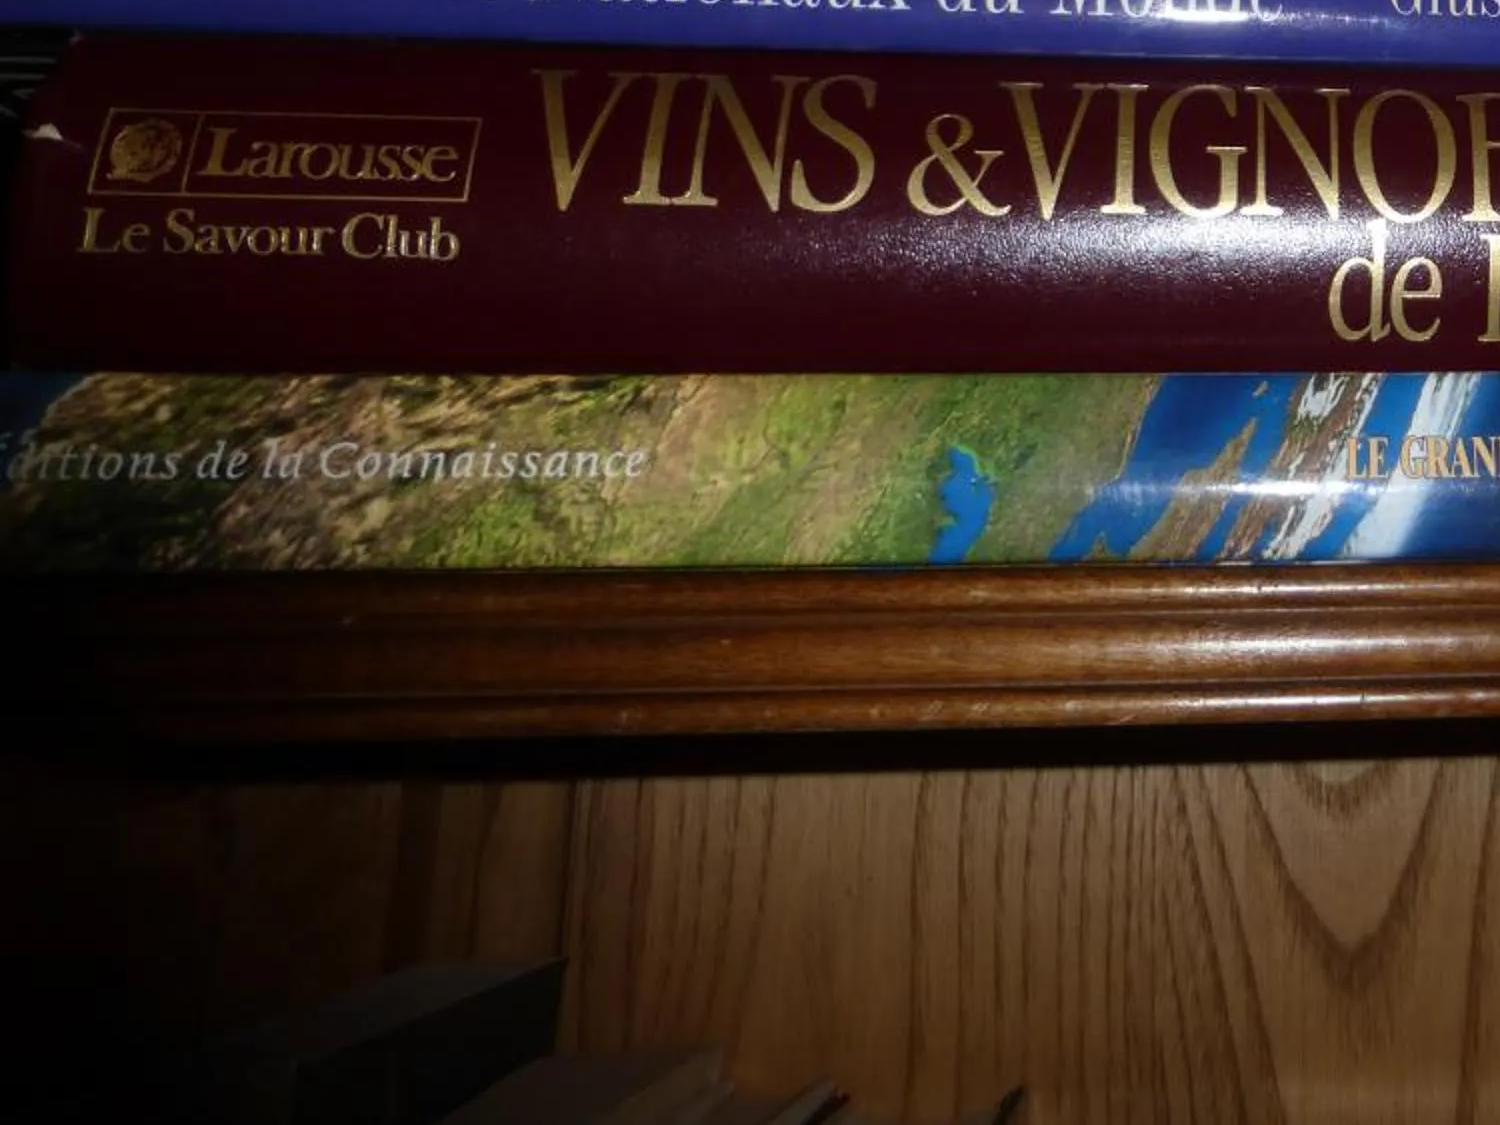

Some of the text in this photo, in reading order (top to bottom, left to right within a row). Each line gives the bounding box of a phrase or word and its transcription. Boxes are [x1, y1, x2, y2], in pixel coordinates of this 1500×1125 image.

[198, 127, 459, 184] Larousse
[531, 69, 878, 214] VINS
[906, 111, 1009, 220] &
[78, 208, 460, 264] Le Savour Club
[1327, 218, 1443, 344] de
[0, 432, 650, 481] ditions de la Connaissance
[1346, 435, 1389, 477] LE
